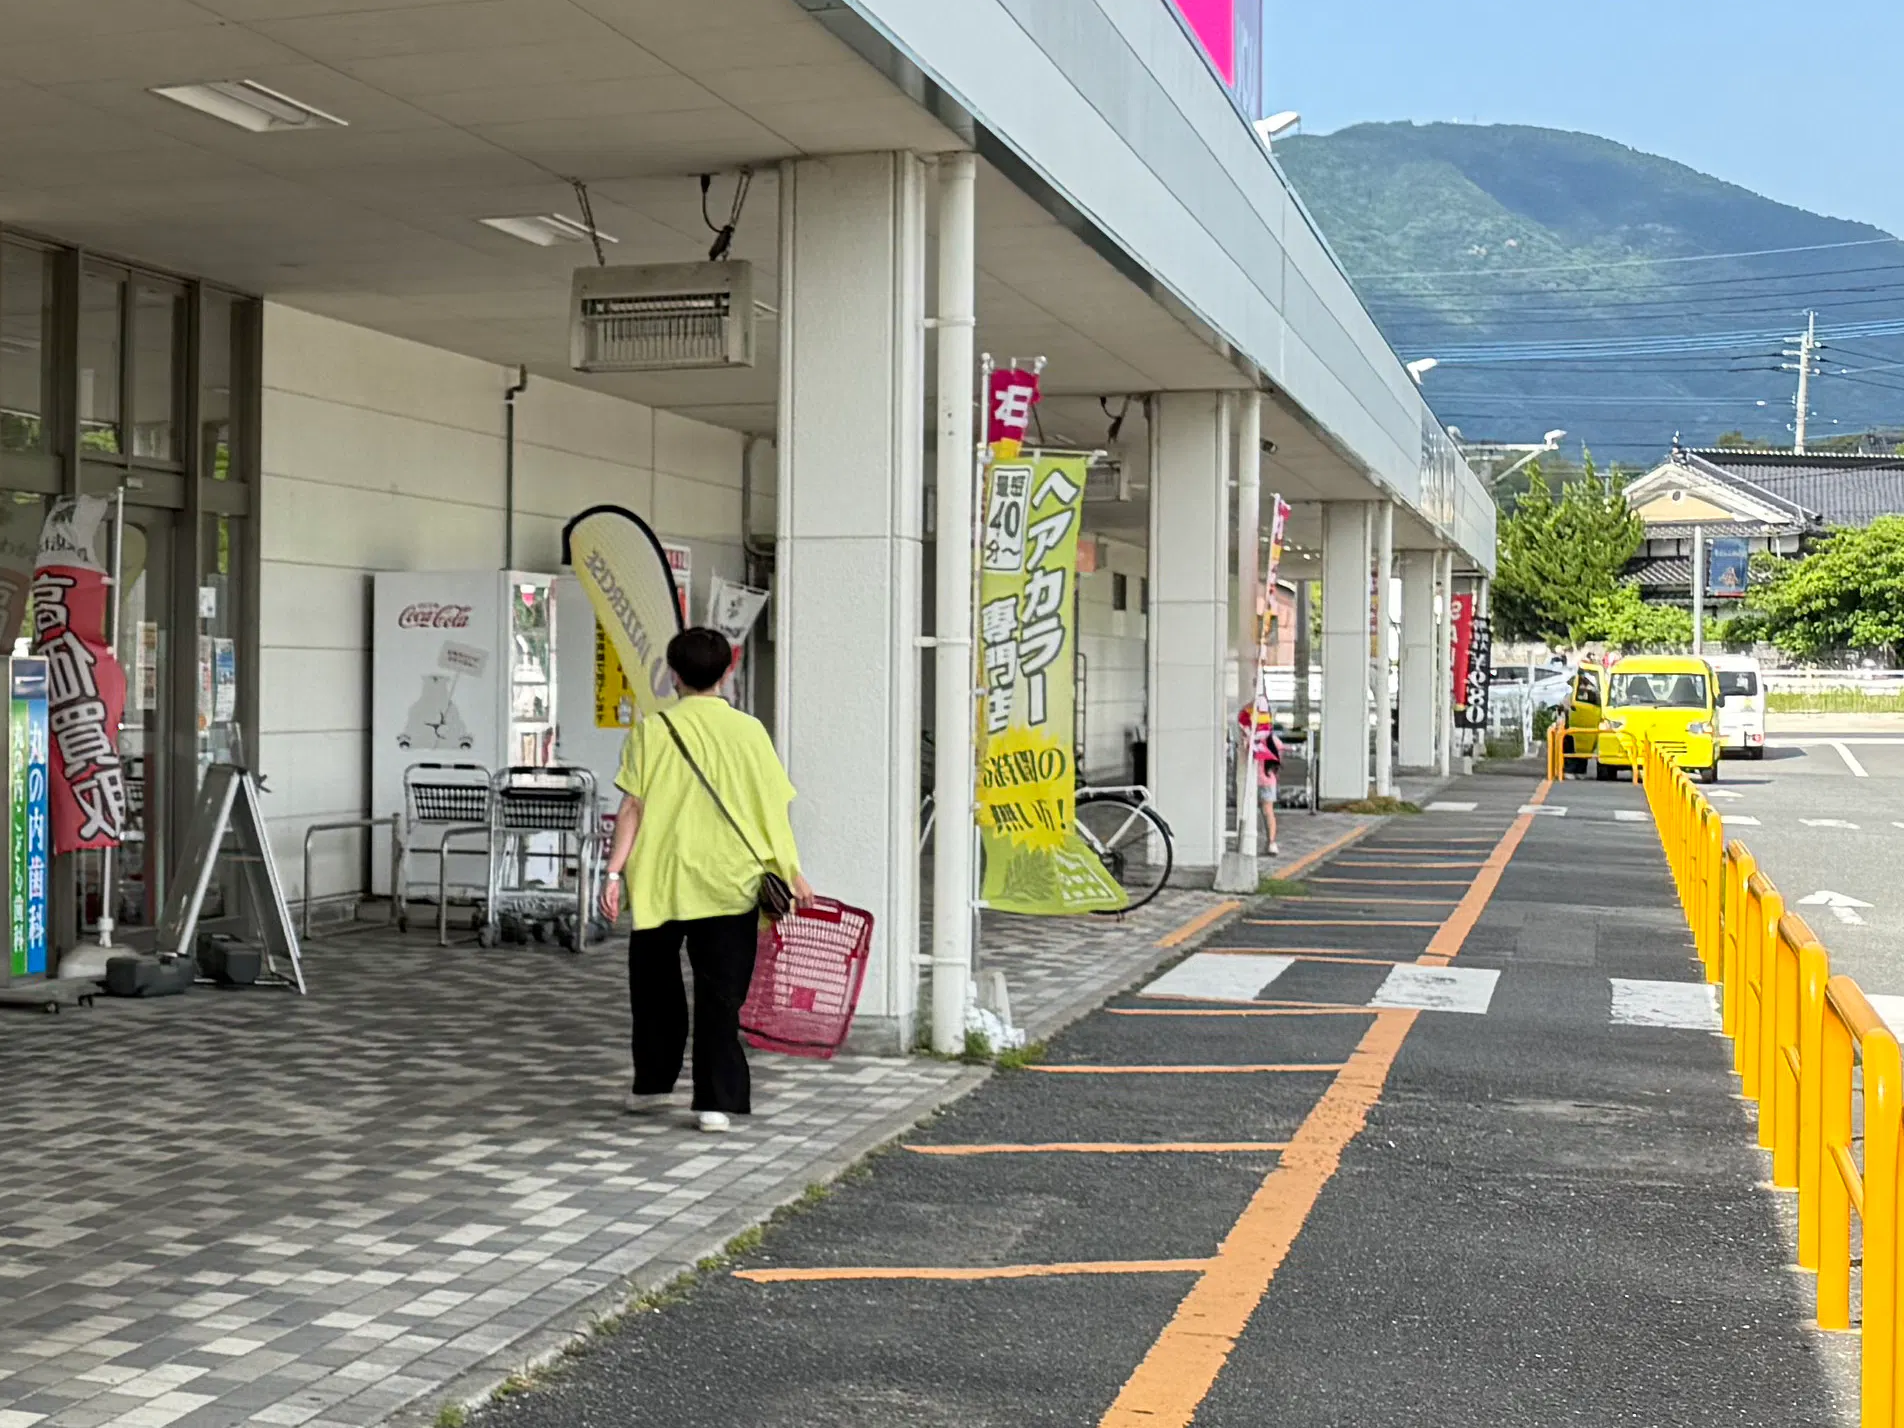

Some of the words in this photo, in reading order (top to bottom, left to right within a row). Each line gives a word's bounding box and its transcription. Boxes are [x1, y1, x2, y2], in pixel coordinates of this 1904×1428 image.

[1019, 468, 1080, 726] ヘアカラー
[28, 720, 46, 949] 丸の内歯科
